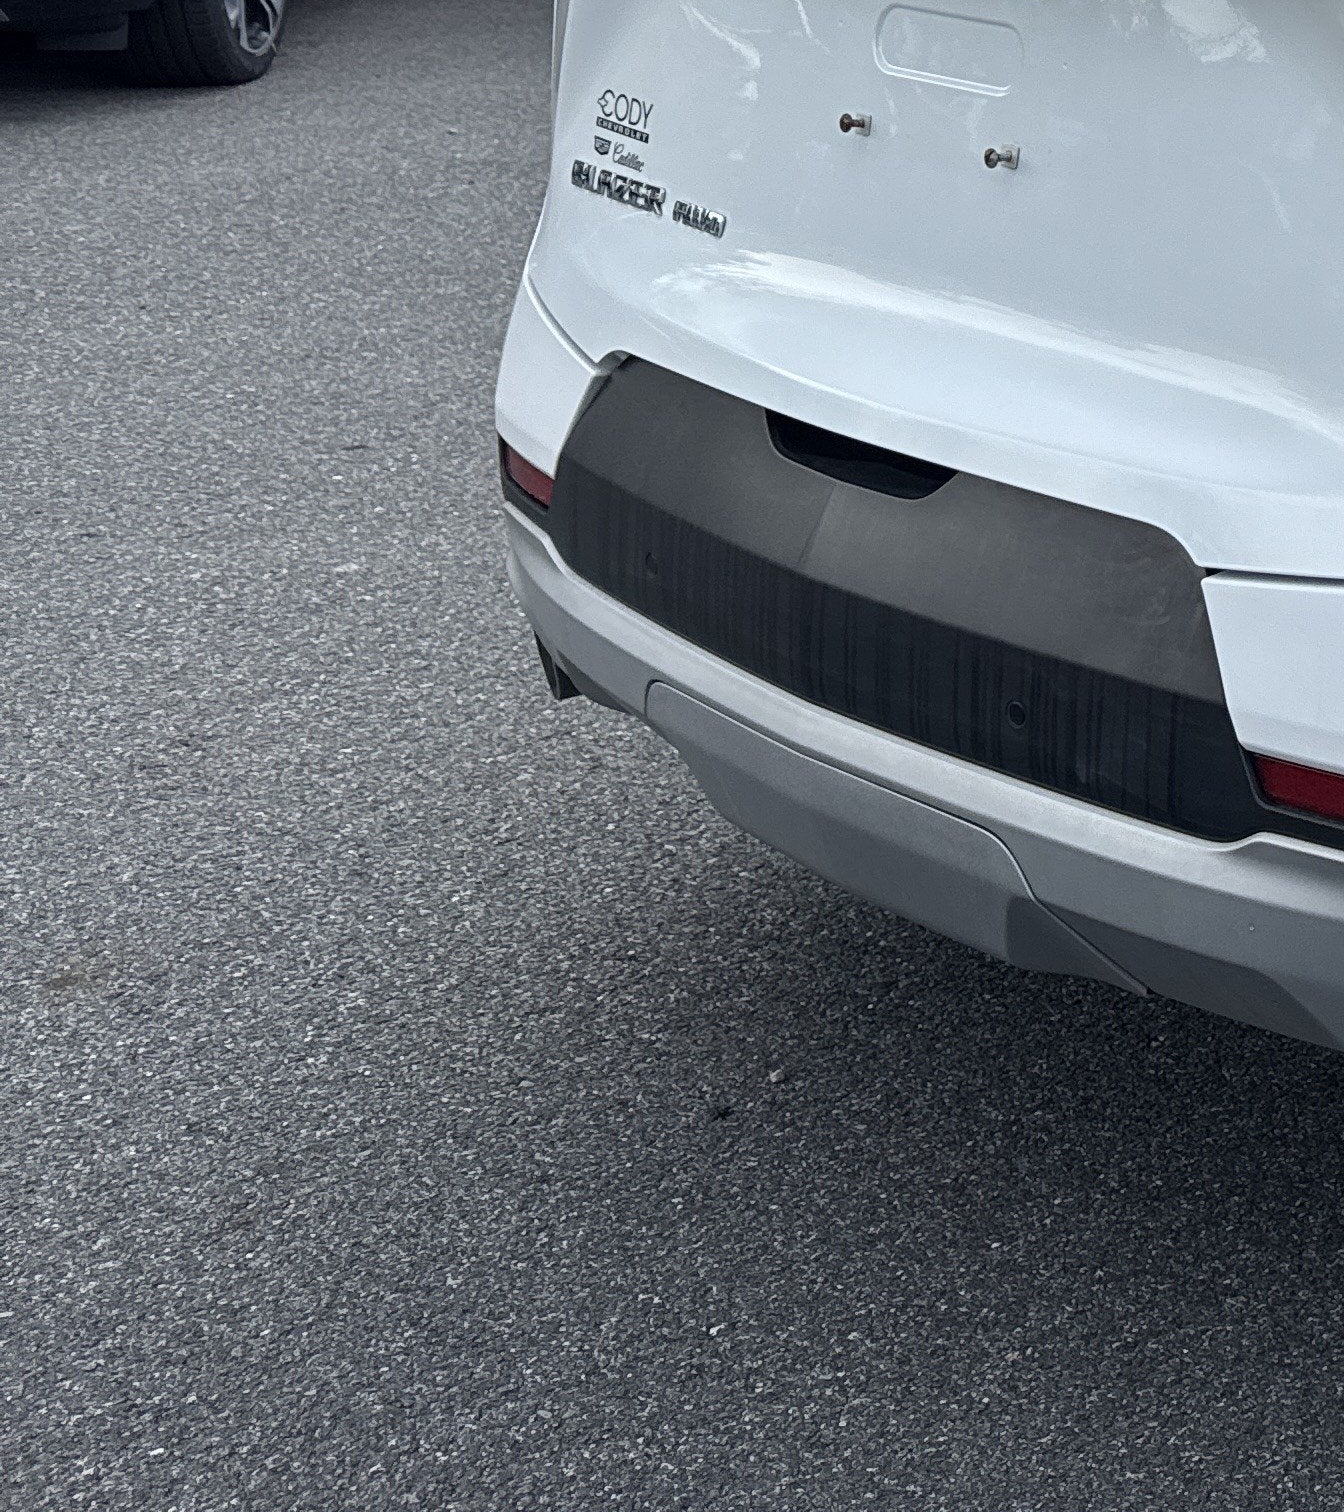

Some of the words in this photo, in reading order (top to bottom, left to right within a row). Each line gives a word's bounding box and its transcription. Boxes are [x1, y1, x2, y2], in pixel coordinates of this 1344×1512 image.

[597, 89, 654, 129] CODY
[598, 117, 649, 143] CHEVROLET
[571, 159, 666, 217] BLAZER
